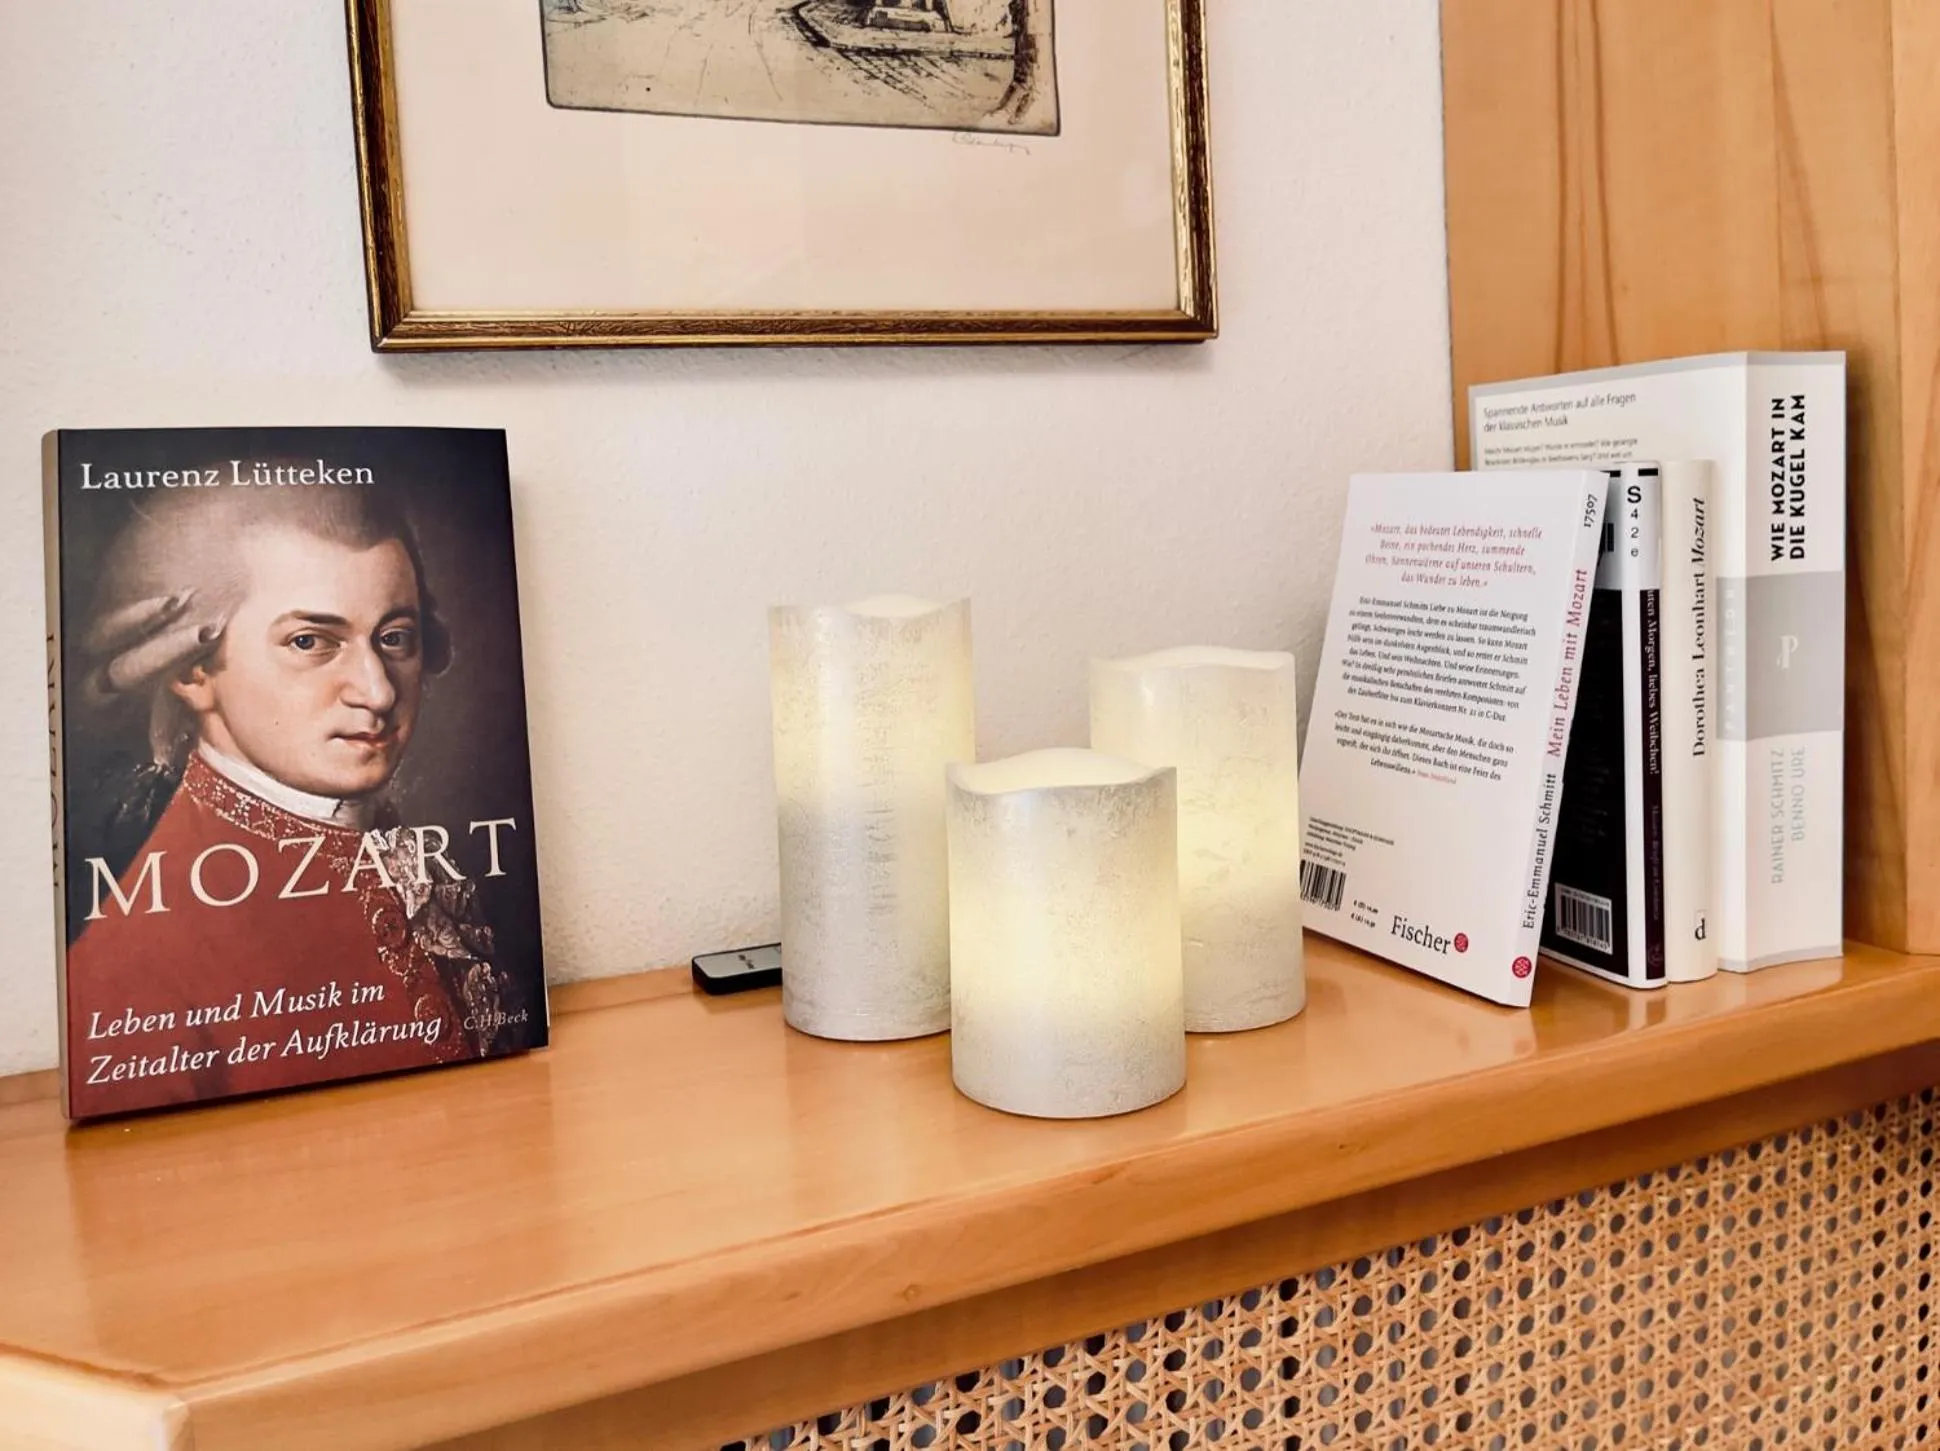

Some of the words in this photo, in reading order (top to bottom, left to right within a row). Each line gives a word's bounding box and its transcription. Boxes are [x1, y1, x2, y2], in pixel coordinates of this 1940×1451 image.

[1484, 405, 1528, 418] Spannende
[1531, 401, 1573, 412] Antworten
[1576, 396, 1589, 408] auf
[1590, 395, 1605, 407] alle
[1606, 393, 1636, 407] Fragen
[1484, 422, 1496, 432] der
[1499, 419, 1542, 430] klassischen
[1545, 415, 1568, 426] Musik
[1772, 398, 1785, 418] IN
[1790, 395, 1805, 440] KAM
[81, 463, 220, 490] Laurenz
[230, 459, 375, 488] Lütteken
[1772, 428, 1785, 514] MOZART
[1790, 449, 1805, 517] KUGEL
[1584, 494, 1598, 528] 17507
[1627, 486, 1642, 503] S
[1453, 526, 1506, 540] Lebendigkeit,
[1509, 527, 1542, 539] schnelle
[1691, 498, 1705, 567] Mozart
[1772, 522, 1785, 561] WIE
[1790, 526, 1805, 559] DIE
[1566, 569, 1588, 626] Mozart
[1692, 573, 1705, 660] Leonhart
[1563, 632, 1577, 660] mit
[1645, 621, 1658, 671] Morgen,
[1554, 667, 1573, 711] Leben
[1648, 674, 1658, 708] liebes
[1692, 668, 1705, 756] Dorothea
[1548, 718, 1566, 757] Mein
[1649, 712, 1660, 775] Weibchen!
[1771, 749, 1784, 819] SCHMITZ
[1791, 747, 1805, 778] URE
[1791, 785, 1805, 841] BENNO
[83, 817, 517, 921] MOZART
[1523, 829, 1548, 929] Eric-Emmanuel
[1538, 773, 1557, 824] Schmitt
[1771, 824, 1784, 884] RAINER
[1392, 915, 1451, 954] Fischer
[1695, 918, 1706, 940] d
[89, 1006, 181, 1040] Leben
[187, 998, 242, 1024] und
[250, 981, 342, 1019] Musik
[351, 980, 385, 1004] im
[87, 1050, 221, 1086] Zeitalter
[227, 1042, 276, 1066] der
[282, 1017, 442, 1062] Aufklärung
